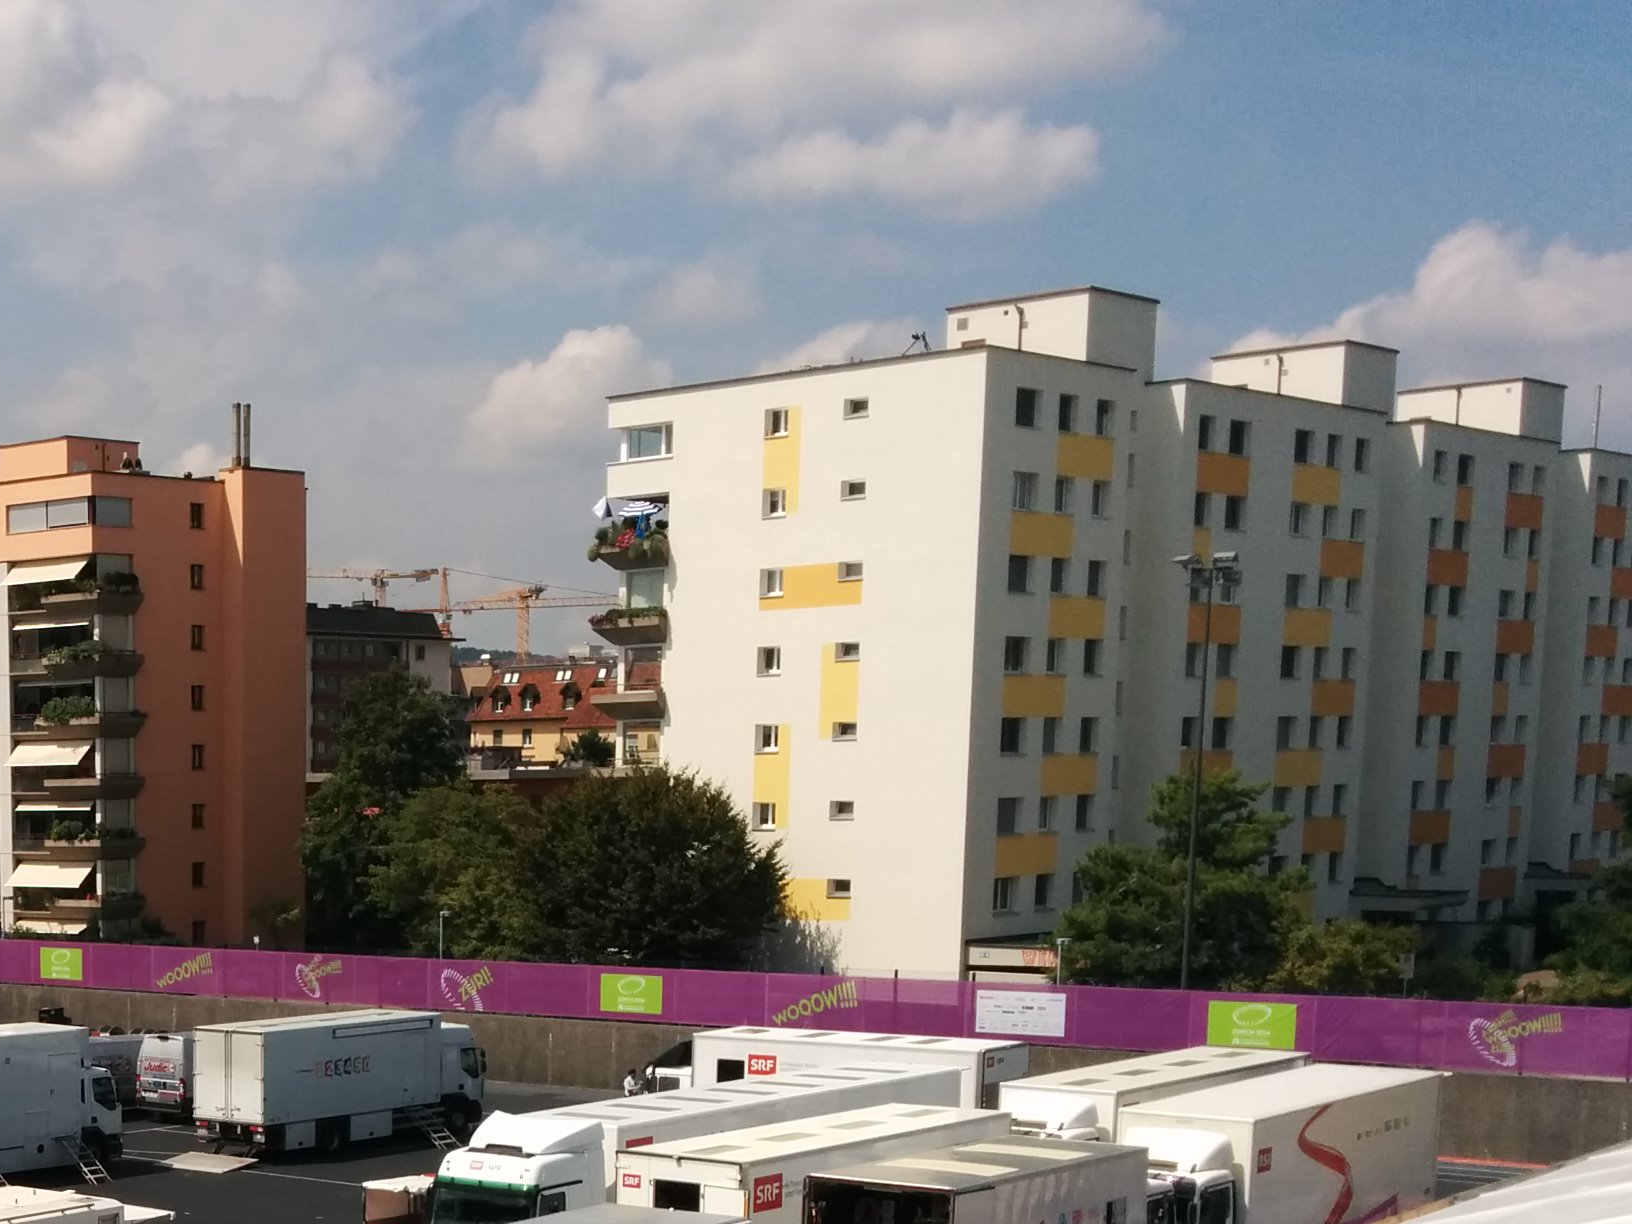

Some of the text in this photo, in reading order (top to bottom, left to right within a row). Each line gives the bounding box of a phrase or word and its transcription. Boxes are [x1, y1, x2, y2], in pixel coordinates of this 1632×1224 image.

[750, 1058, 774, 1071] SRF
[624, 1176, 640, 1185] SRF
[756, 1182, 780, 1204] SRF
